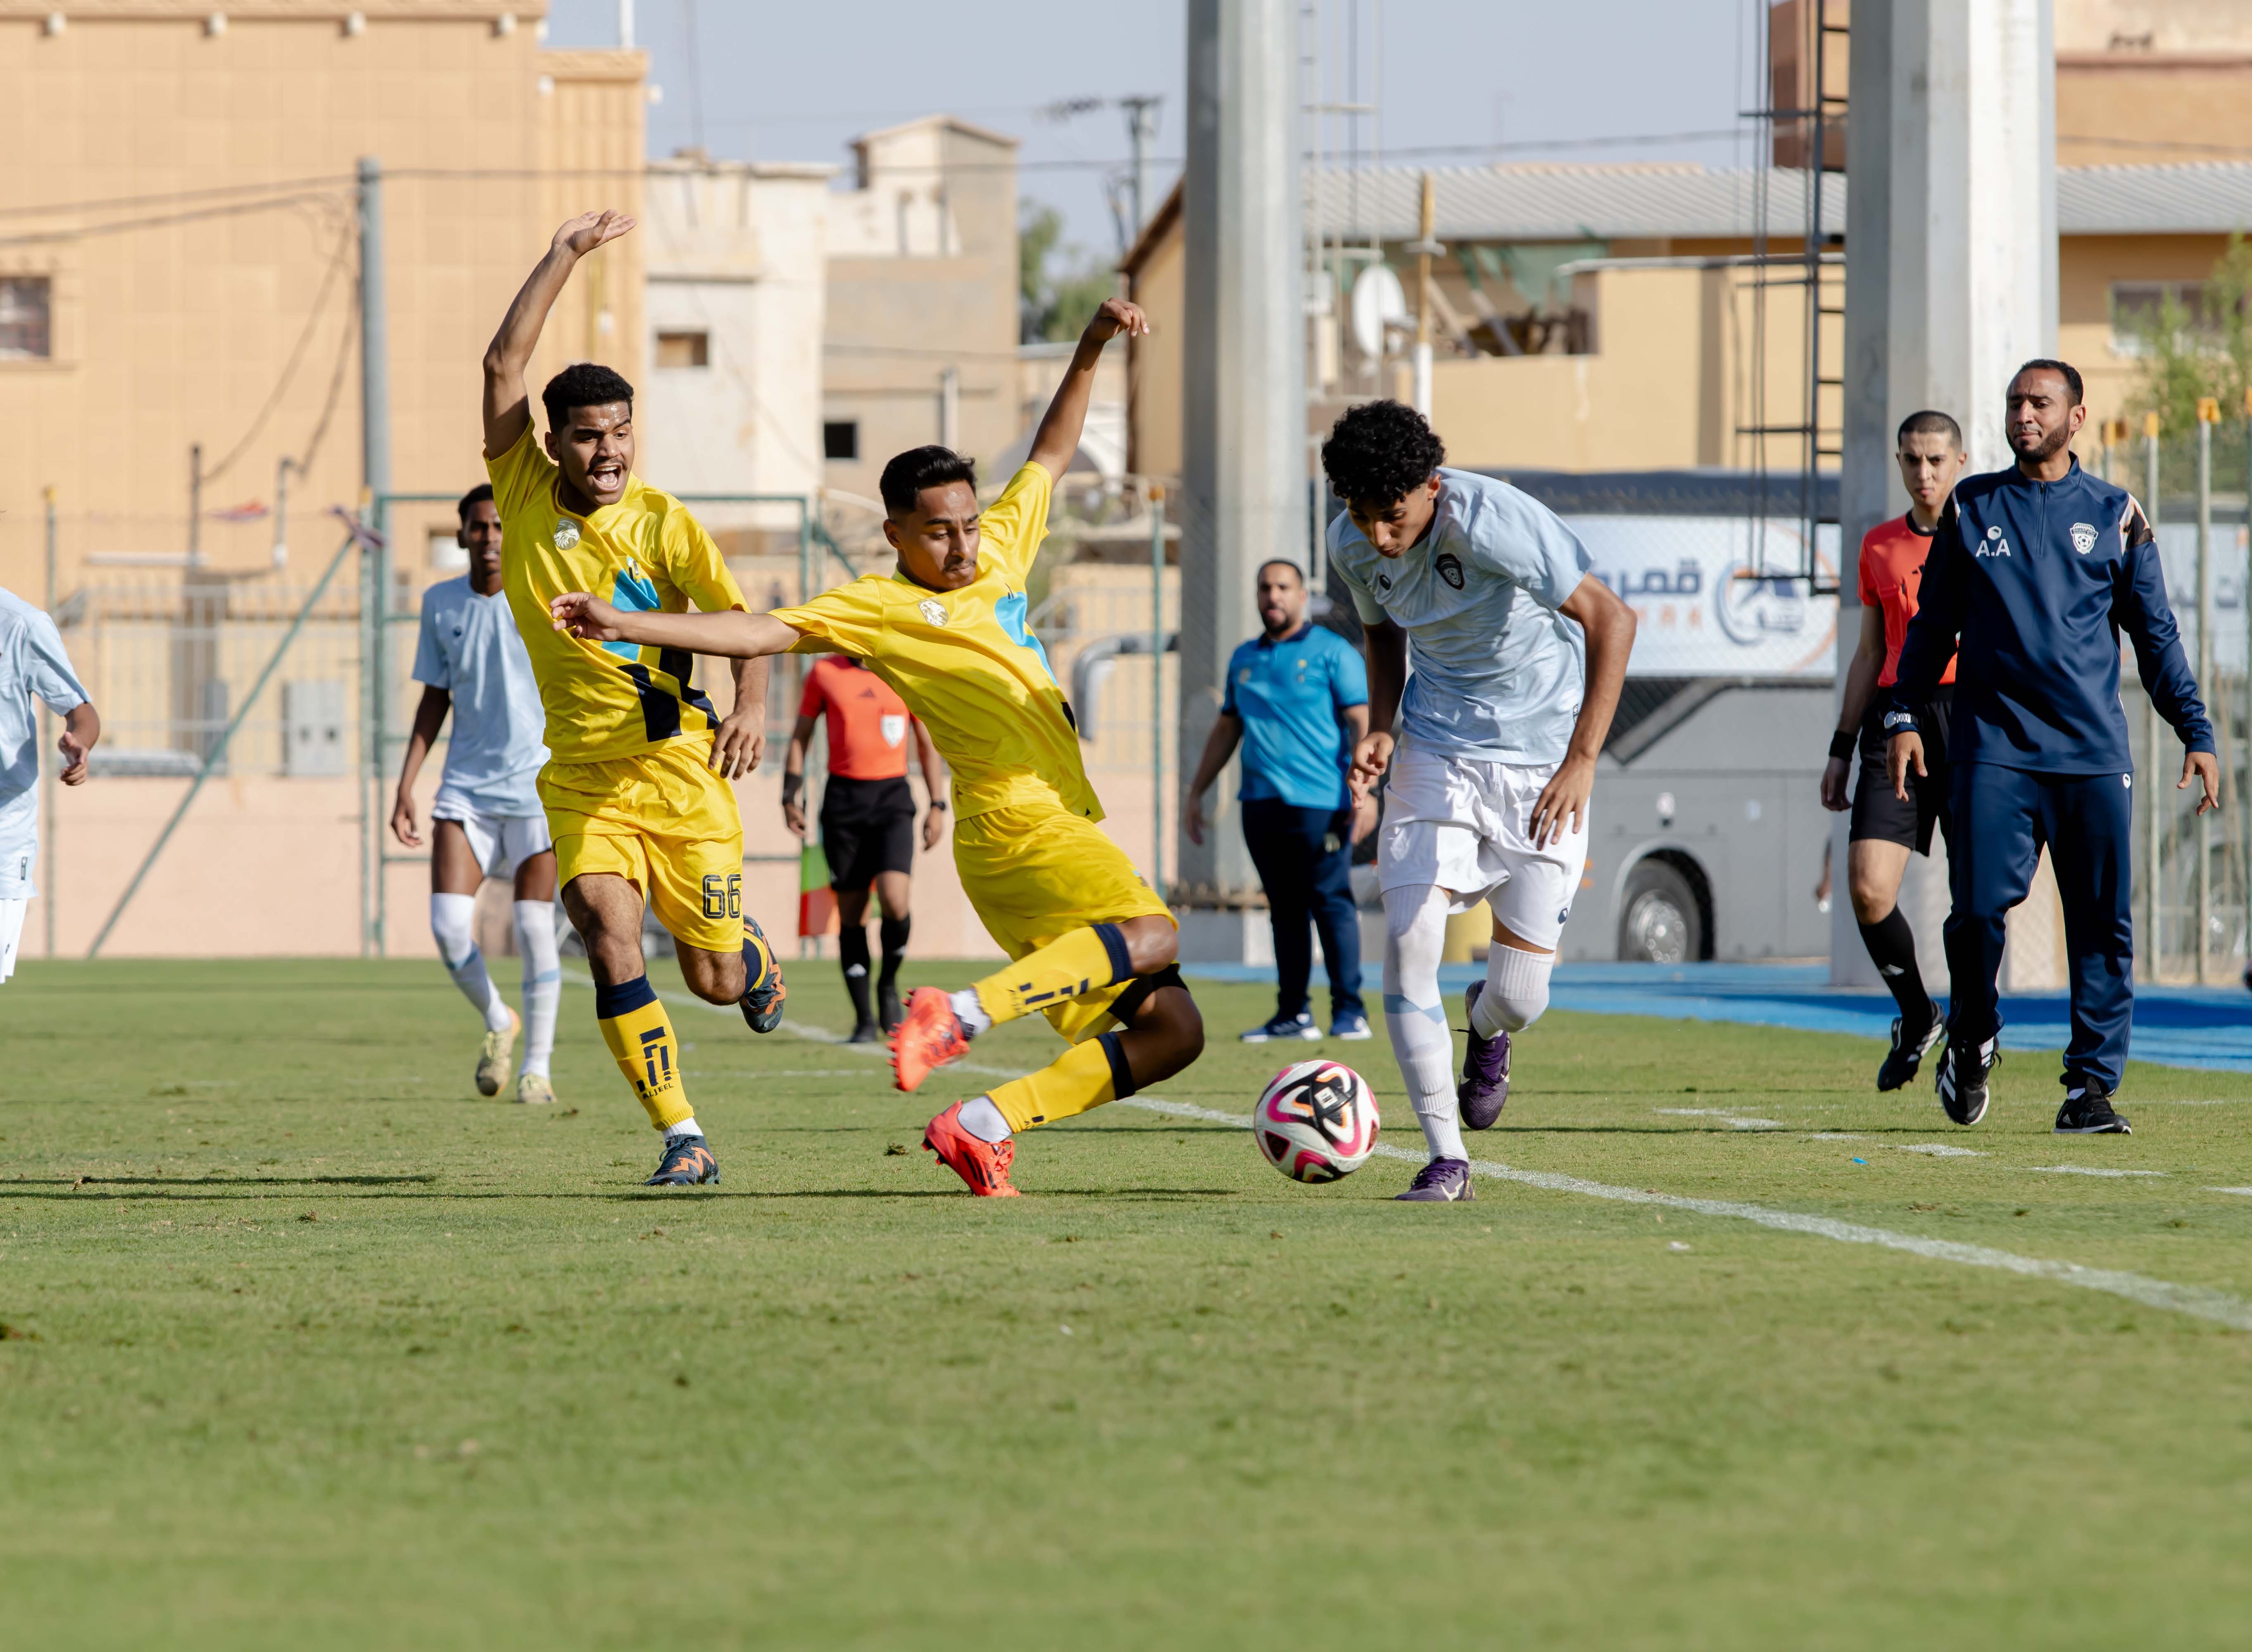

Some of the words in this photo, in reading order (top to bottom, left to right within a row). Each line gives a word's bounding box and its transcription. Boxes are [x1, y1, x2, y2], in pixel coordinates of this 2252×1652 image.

[1975, 538, 2011, 557] A.A
[702, 874, 742, 919] 66
[643, 1083, 674, 1100] ALJEEL
